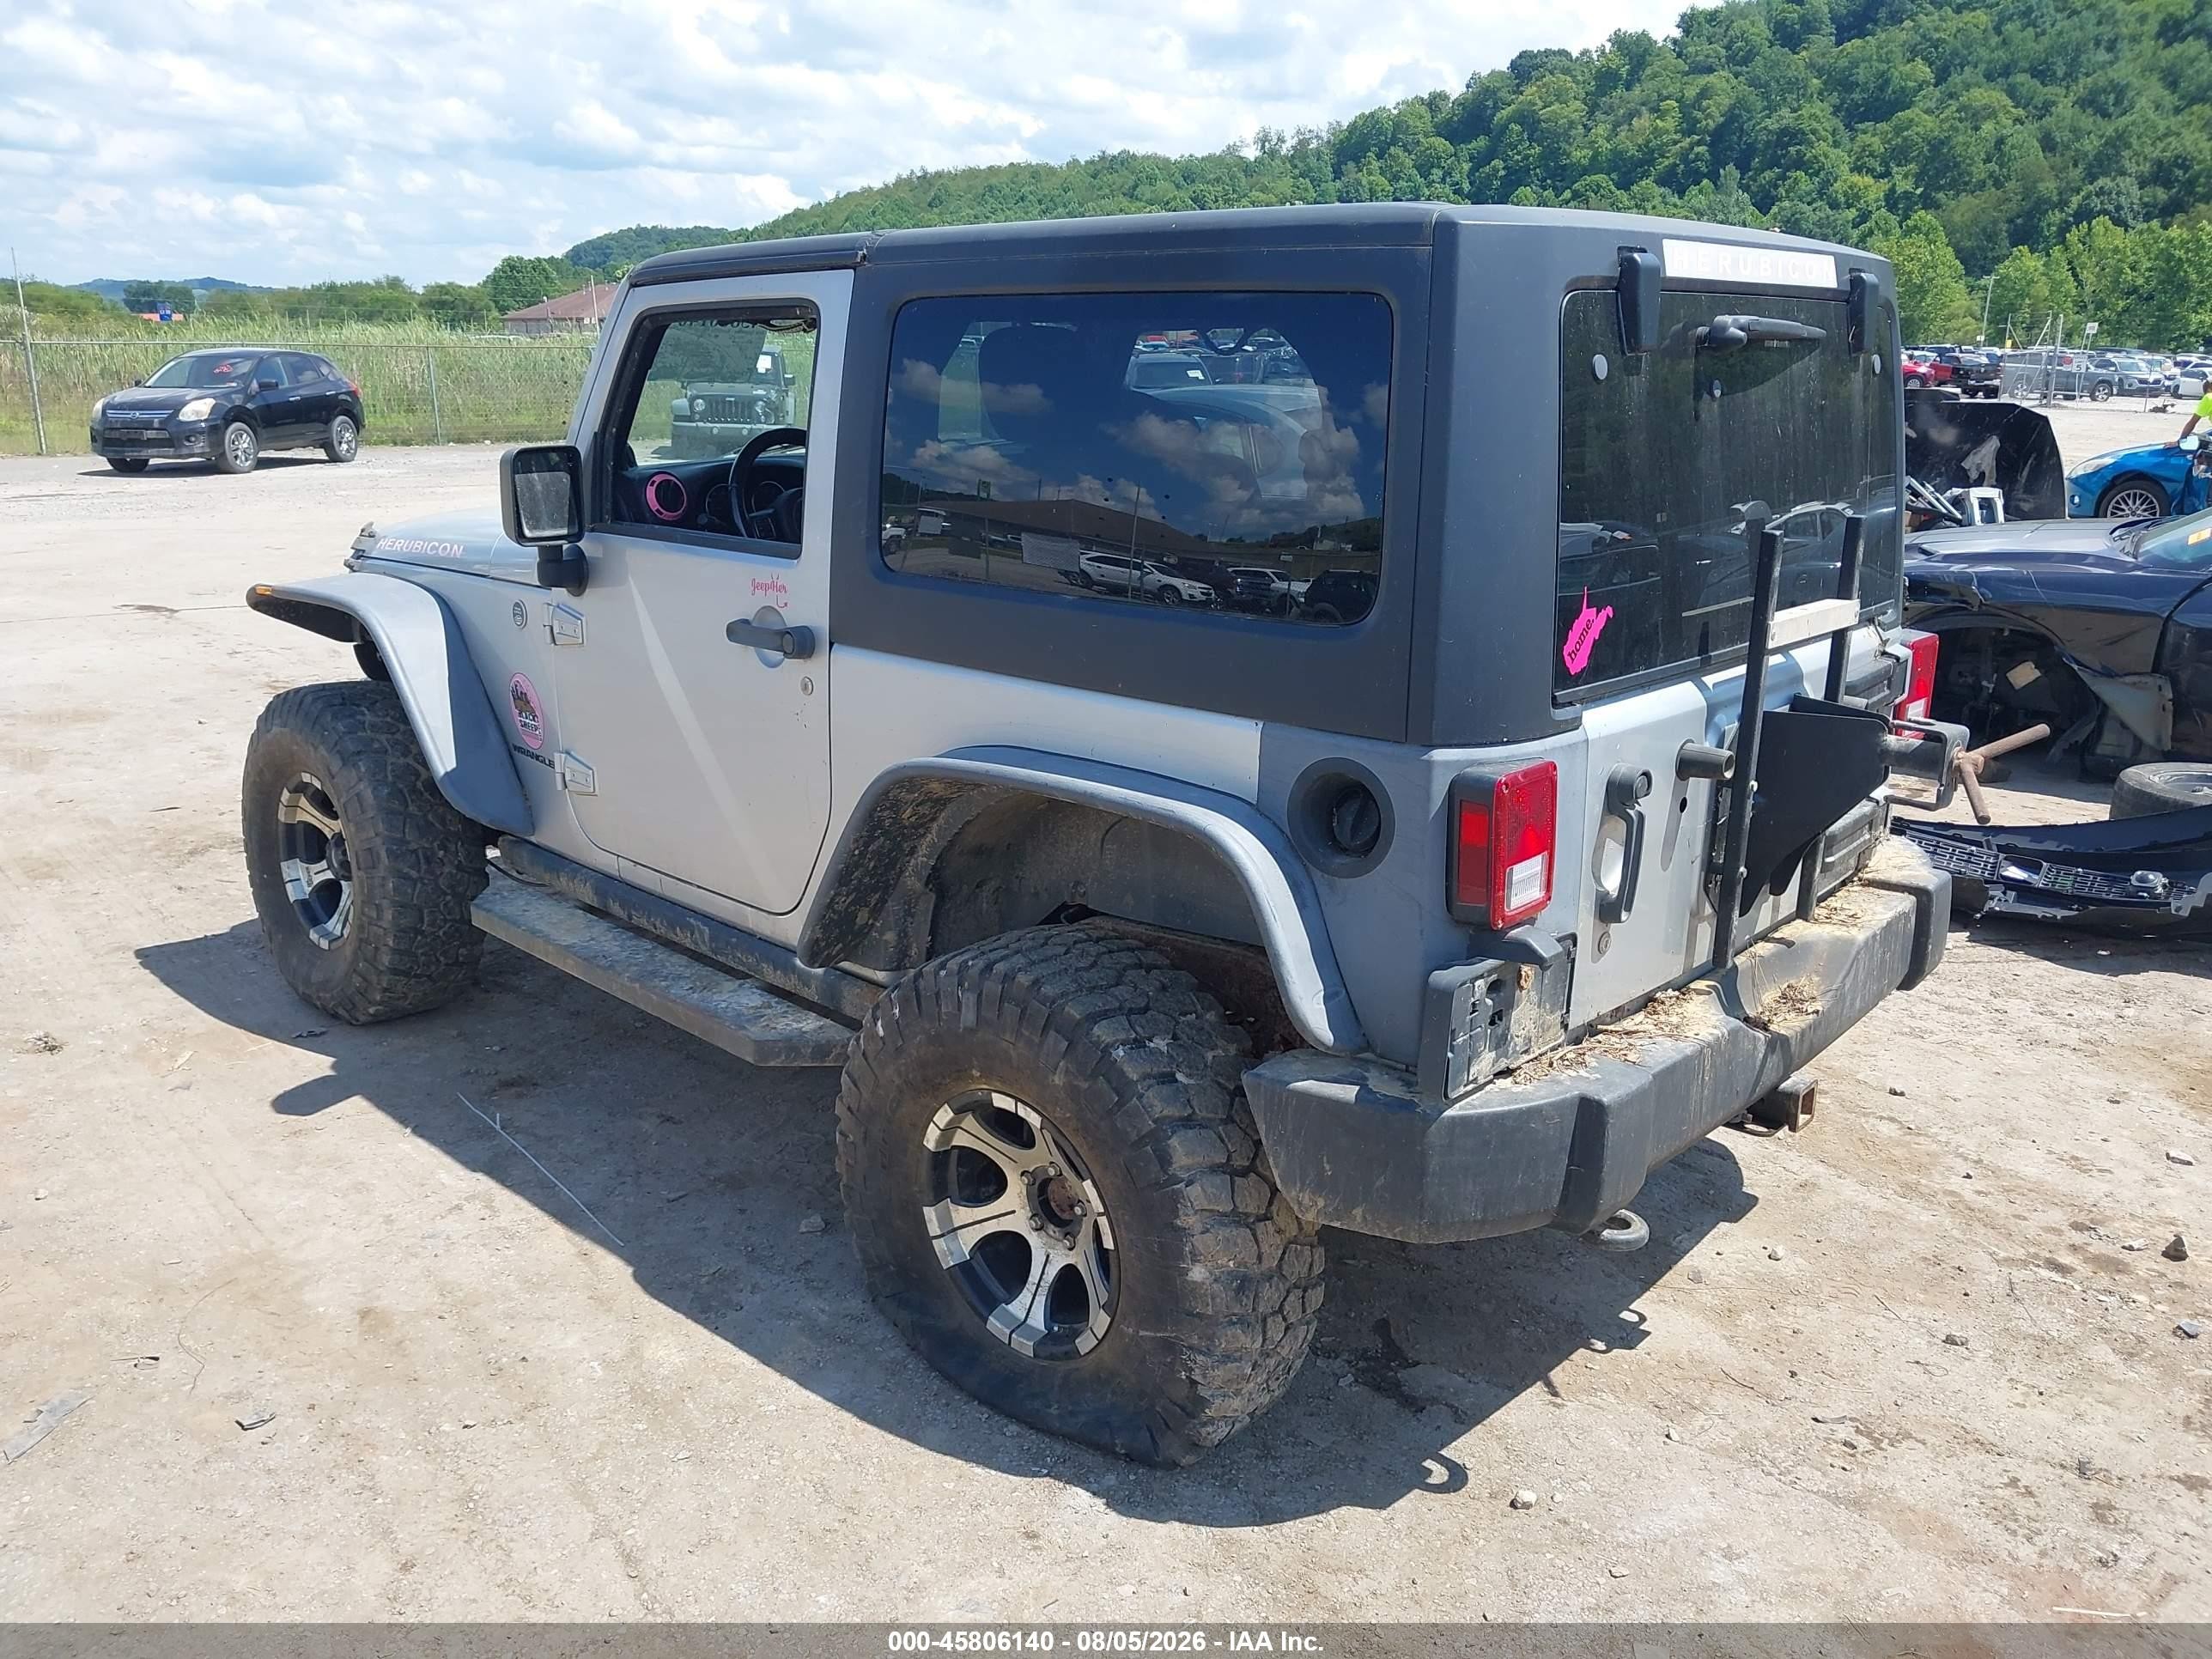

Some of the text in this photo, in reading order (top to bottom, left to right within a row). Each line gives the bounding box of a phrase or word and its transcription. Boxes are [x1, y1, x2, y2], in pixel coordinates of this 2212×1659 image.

[1673, 247, 1837, 281] HERUBICON
[376, 538, 463, 557] HERUBICON
[1567, 618, 1595, 665] home.
[512, 744, 555, 769] WRANGLE
